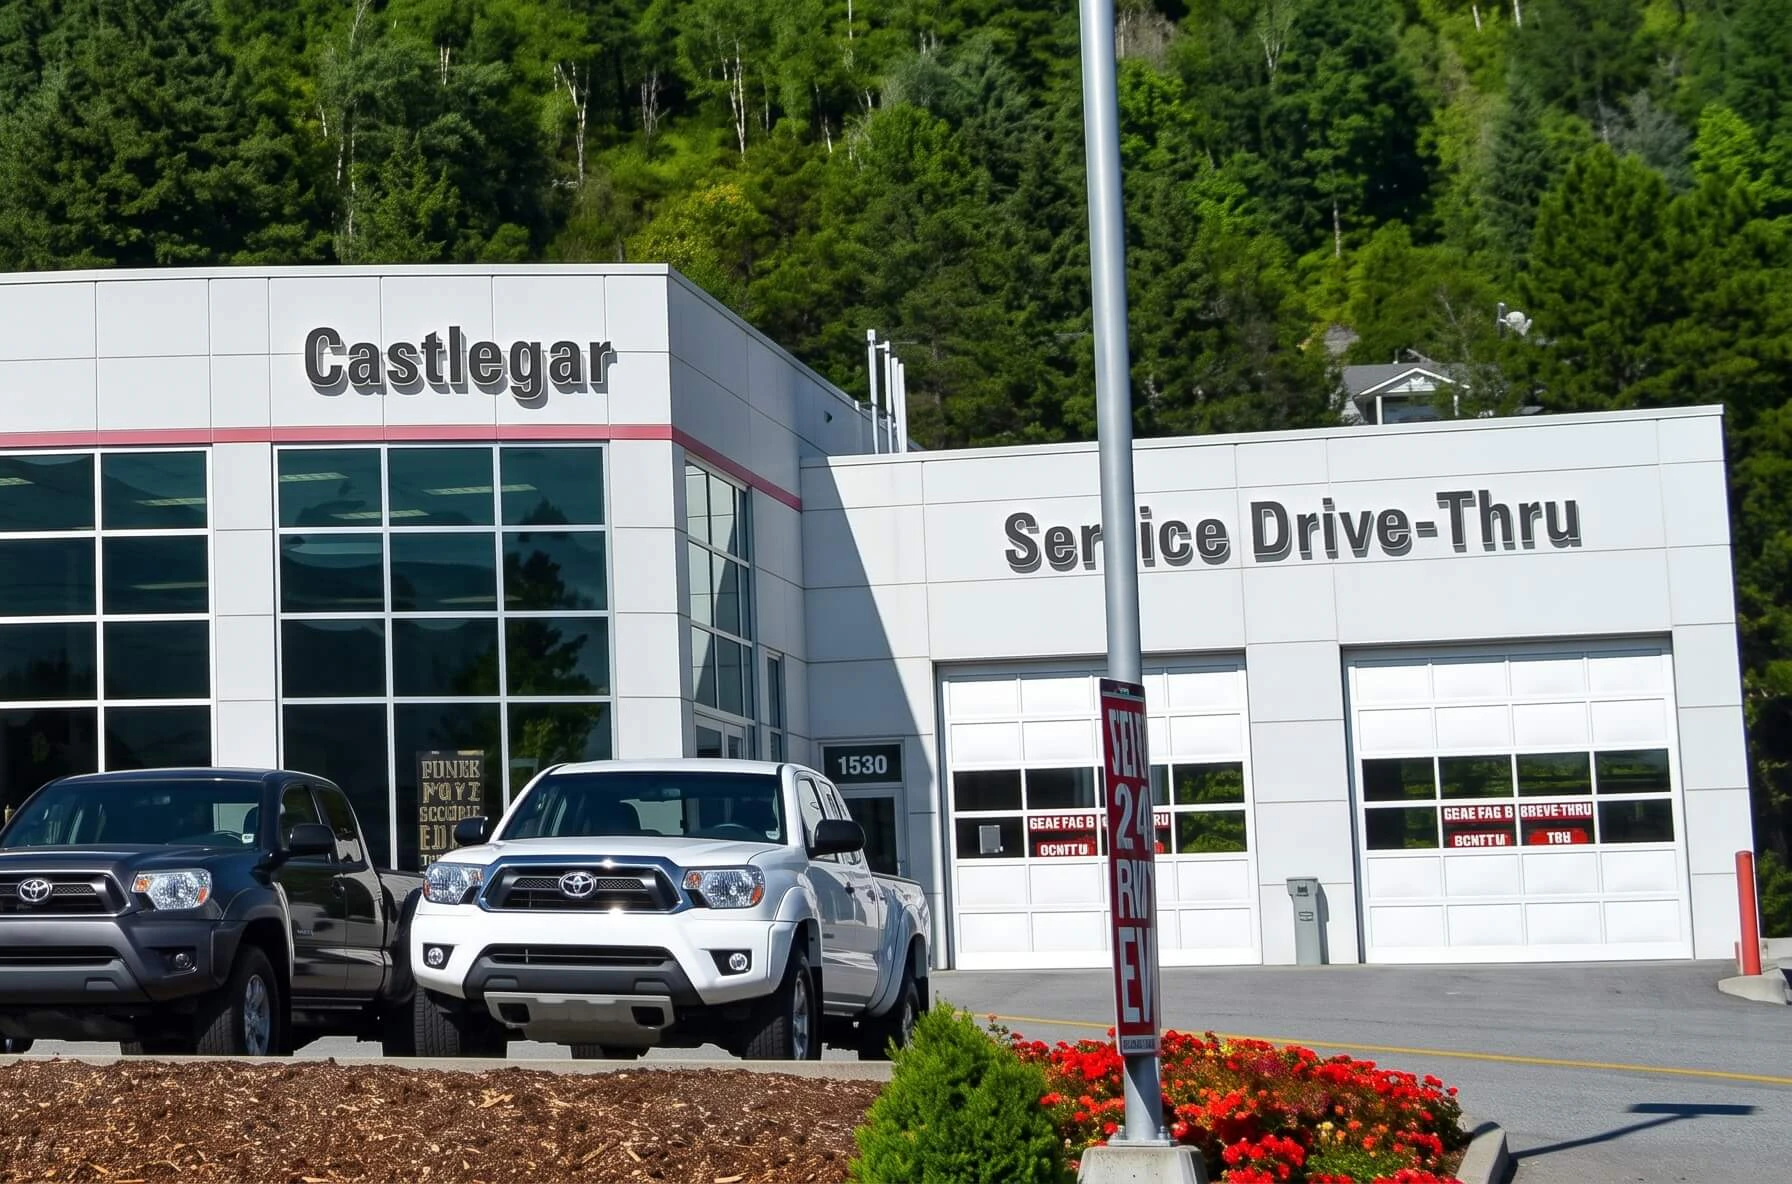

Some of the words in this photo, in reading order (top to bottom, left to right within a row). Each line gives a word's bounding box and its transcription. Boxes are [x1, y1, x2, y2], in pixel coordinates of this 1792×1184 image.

[305, 325, 614, 401] Castlegar
[1004, 504, 1230, 570] Serice
[1250, 489, 1582, 562] Drive-Thru
[837, 754, 888, 775] 1530
[1114, 782, 1152, 850] 24
